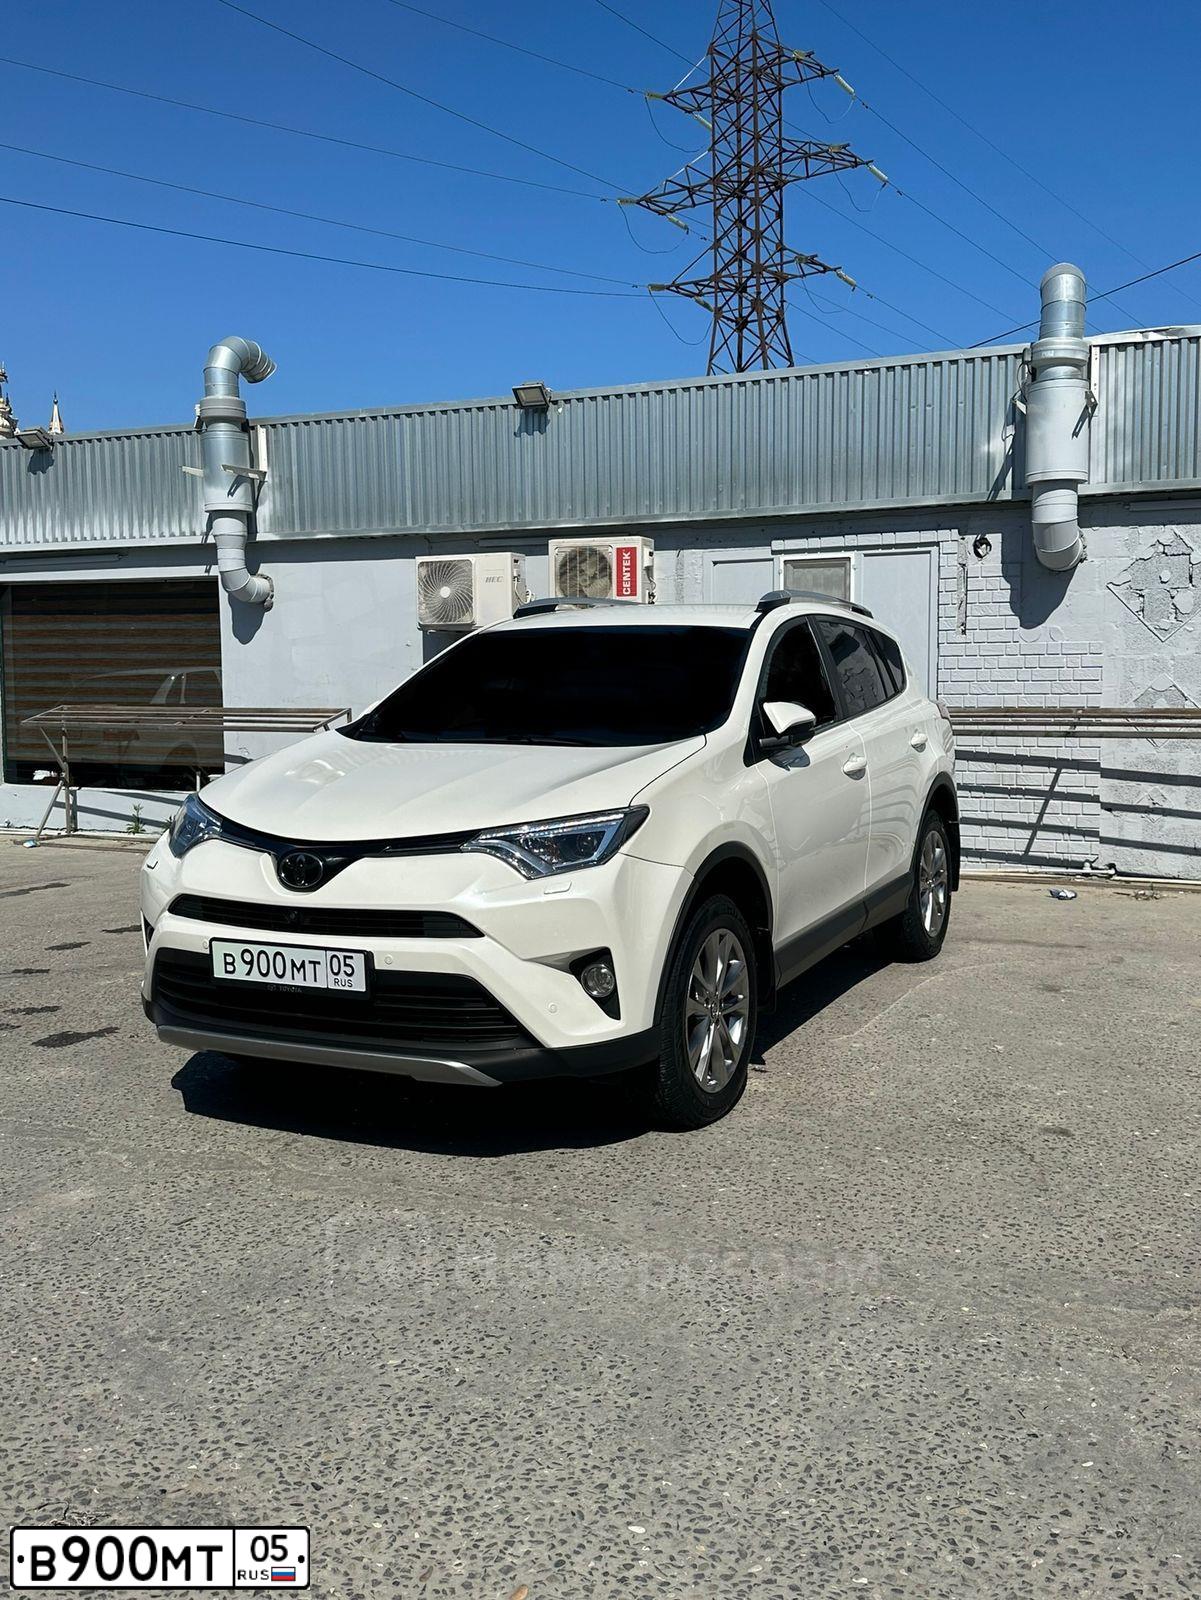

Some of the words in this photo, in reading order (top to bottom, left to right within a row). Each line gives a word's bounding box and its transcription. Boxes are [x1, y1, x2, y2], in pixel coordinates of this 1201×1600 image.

[622, 551, 631, 595] CENTEK
[329, 954, 355, 977] 05
[333, 978, 353, 987] RUS
